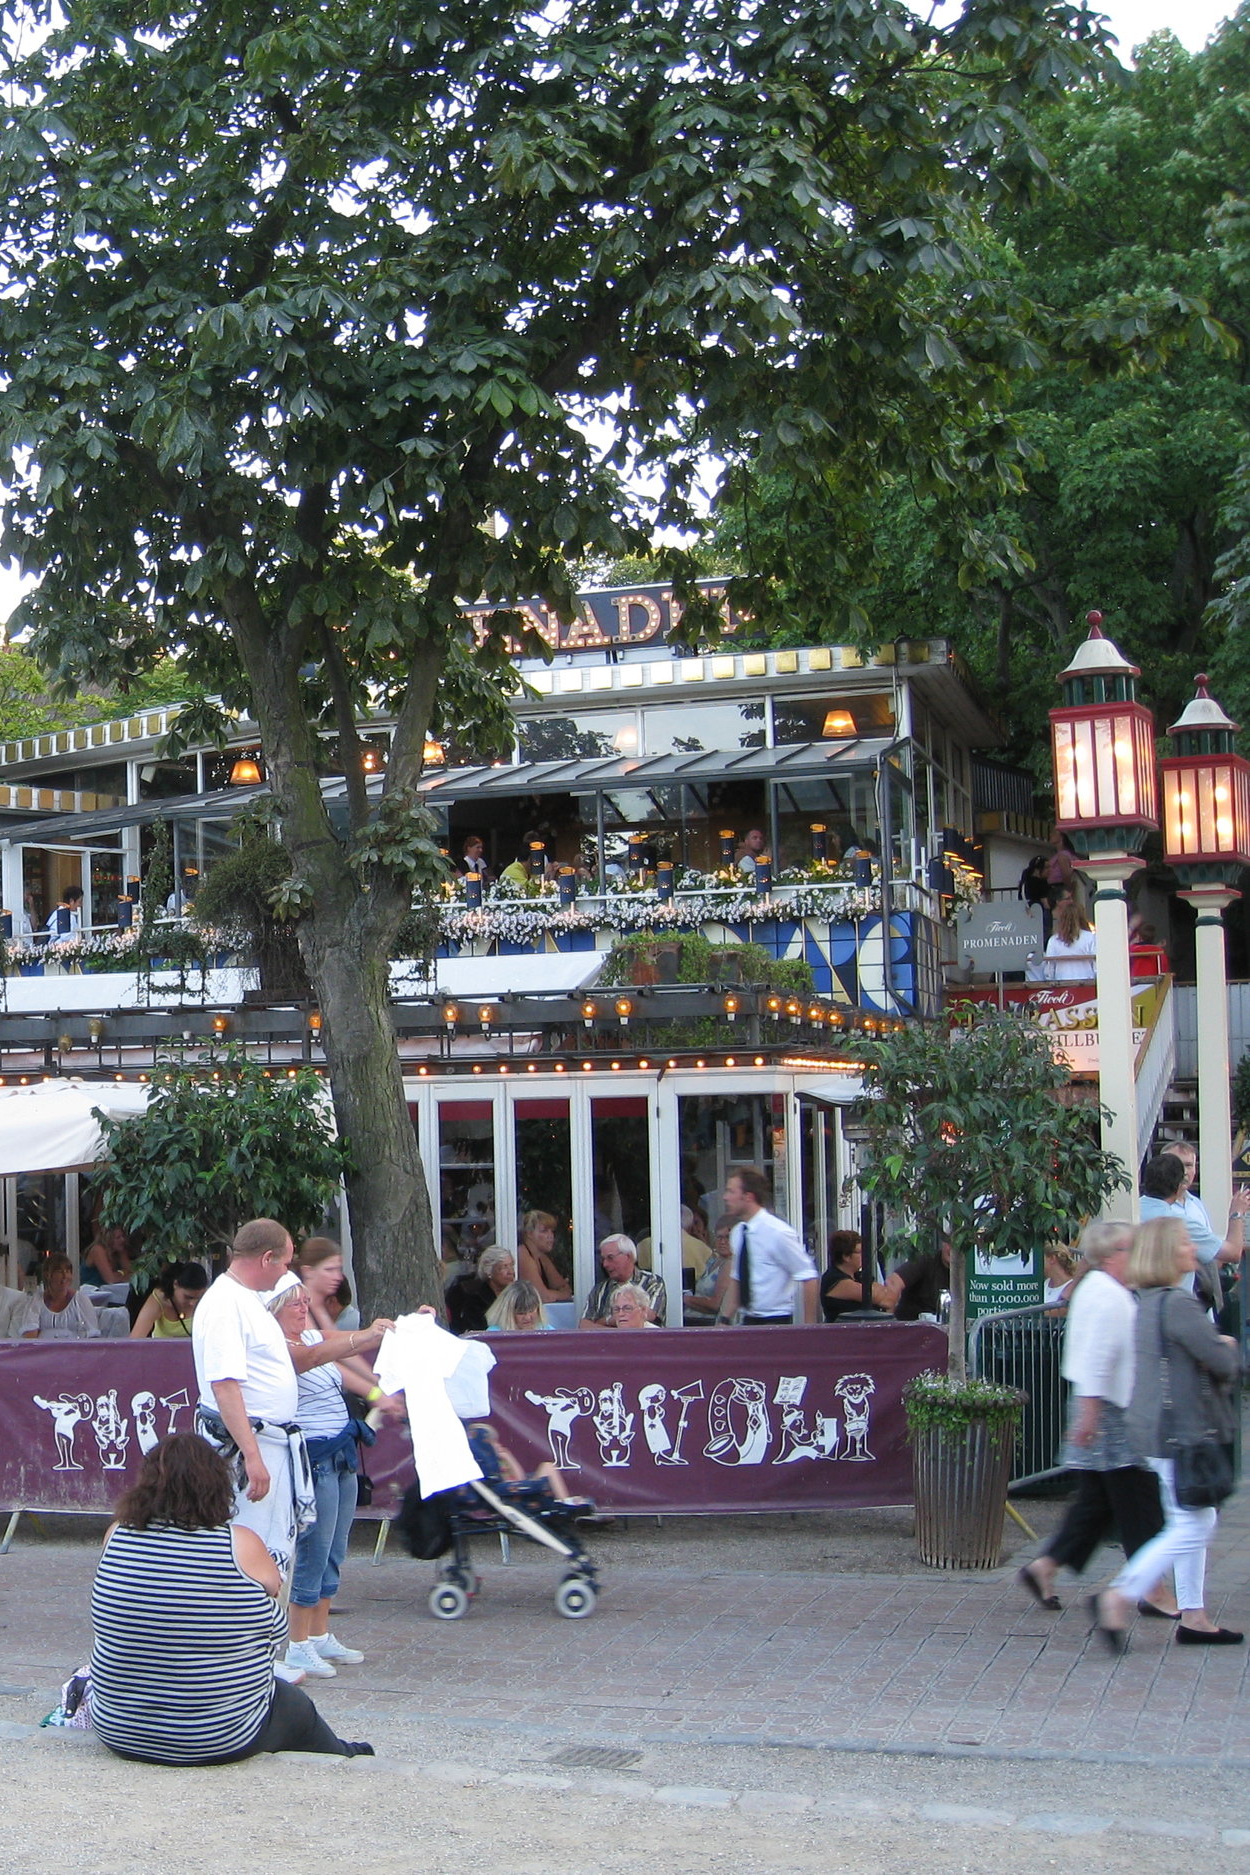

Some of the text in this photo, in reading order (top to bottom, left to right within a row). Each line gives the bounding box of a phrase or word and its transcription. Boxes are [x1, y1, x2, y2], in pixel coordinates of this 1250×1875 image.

[986, 921, 1016, 934] Tivoli
[963, 935, 1038, 949] PROMENADEN
[1029, 990, 1074, 1005] Tivoli
[970, 1280, 1039, 1291] Now sold more
[969, 1291, 1040, 1304] than 1.000.000
